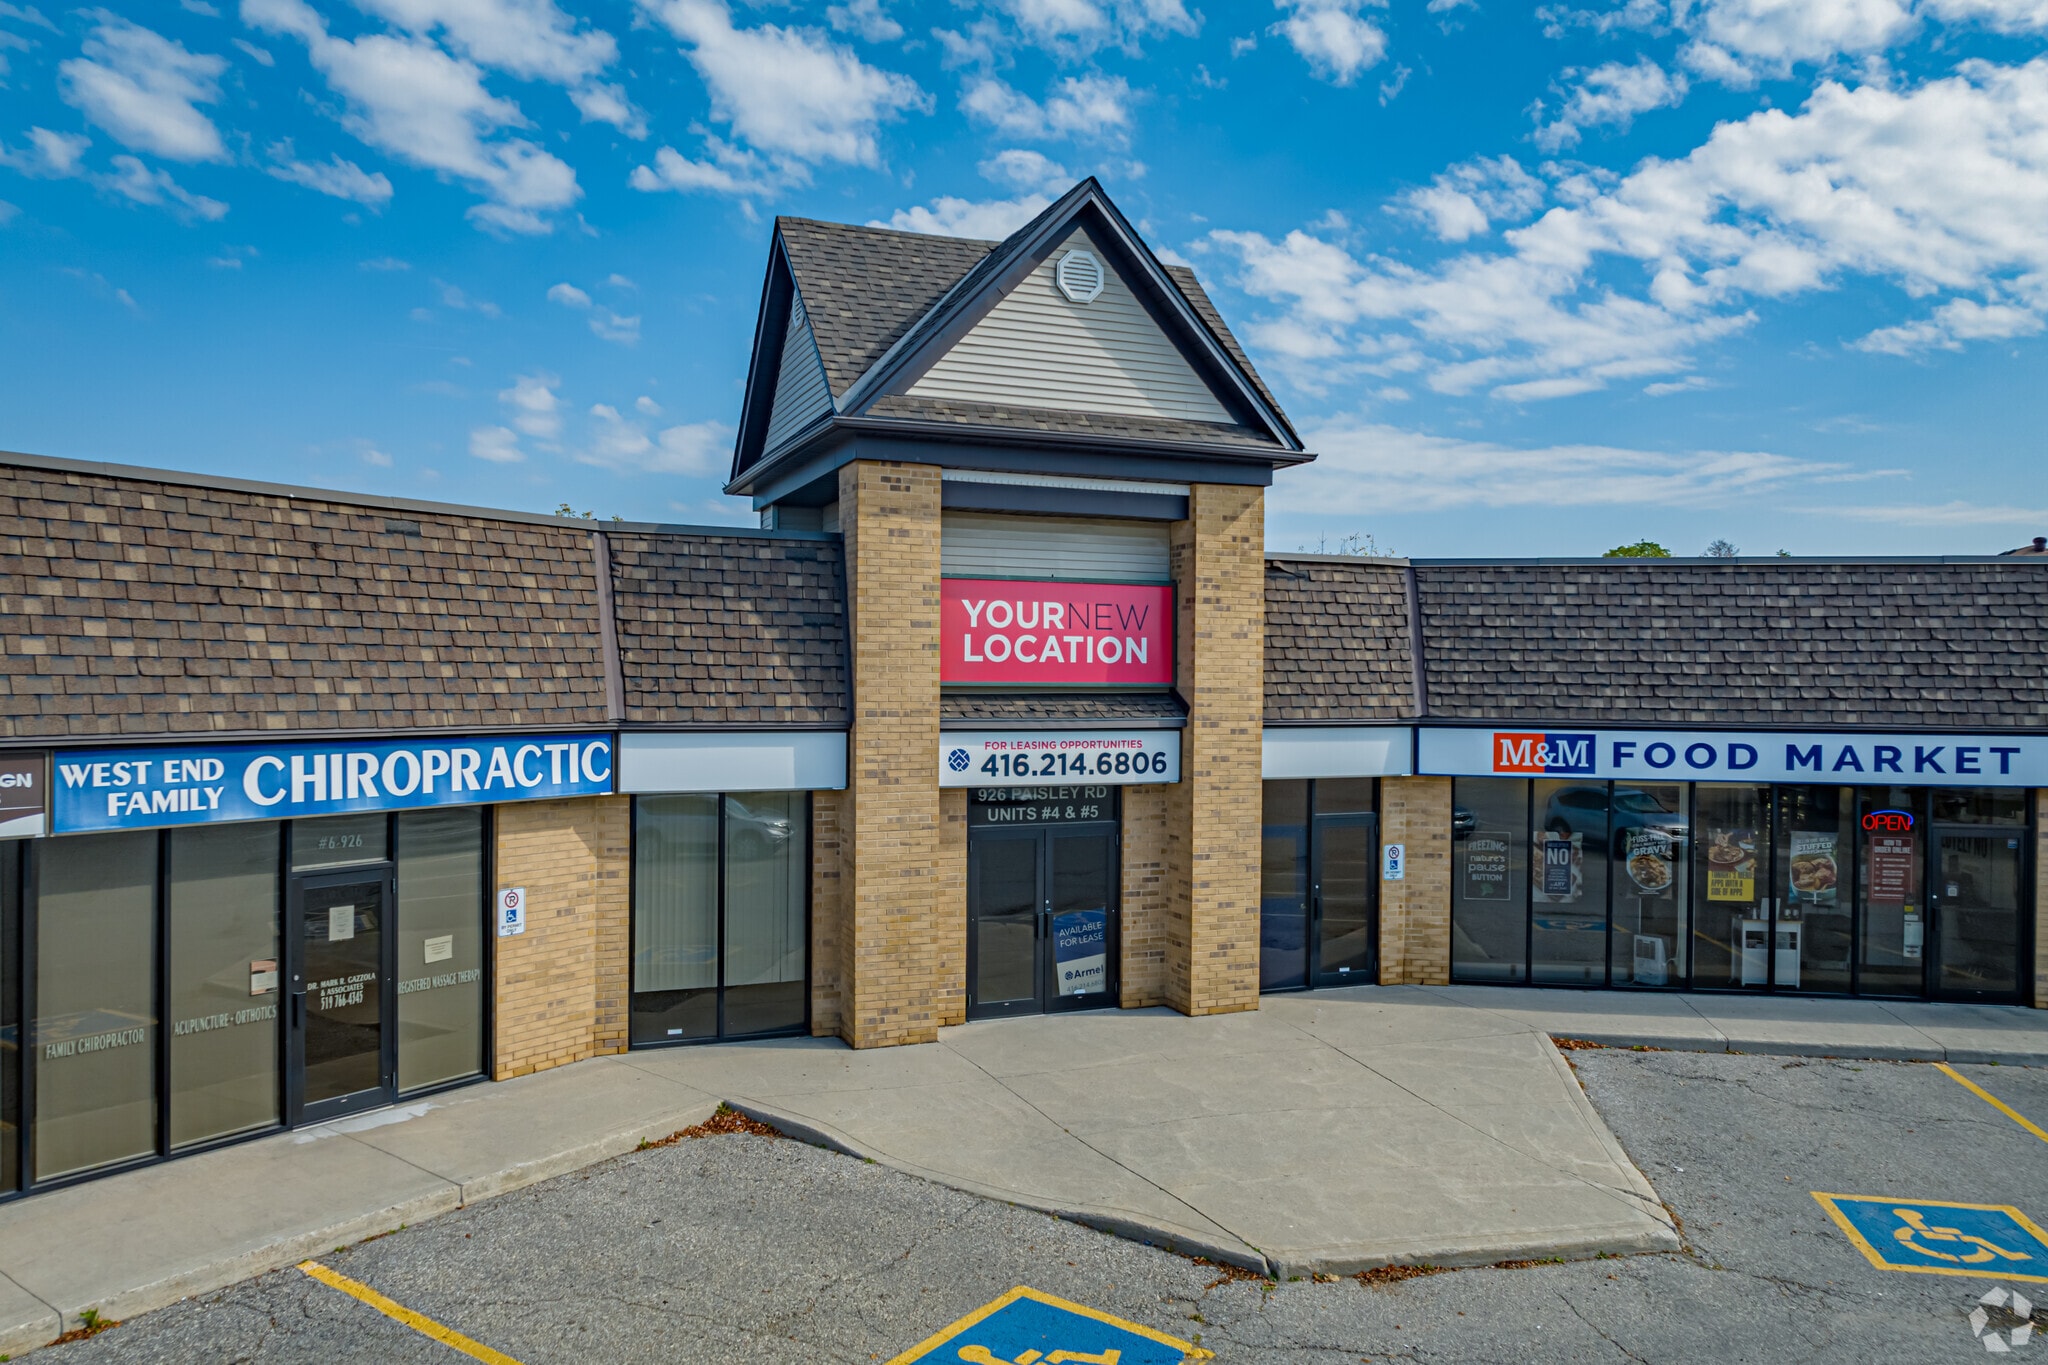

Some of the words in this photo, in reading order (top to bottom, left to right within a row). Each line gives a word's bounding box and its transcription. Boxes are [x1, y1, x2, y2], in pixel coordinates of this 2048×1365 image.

[961, 599, 1065, 630] YOUR
[1068, 602, 1149, 632] NEW
[963, 633, 1148, 664] LOCATION
[984, 741, 1008, 750] FOR
[1010, 740, 1057, 750] LEASING
[1060, 739, 1143, 750] OPPORTUNITIES
[980, 751, 1167, 777] 416.214.6806
[1499, 739, 1590, 768] M&M
[1612, 741, 1759, 770] FOOD
[1785, 743, 2021, 775] MARKET
[59, 760, 152, 789] WEST
[163, 758, 225, 784] END
[242, 741, 611, 806] CHIROPRACTIC
[107, 786, 225, 817] FAMILY
[977, 787, 1006, 802] 926
[1011, 785, 1081, 801] PAISLEY
[1084, 785, 1107, 799] RD
[987, 806, 1037, 821] UNITS
[1041, 806, 1060, 820] #4
[1064, 805, 1076, 819] &
[1080, 805, 1098, 819] #5
[1862, 813, 1911, 831] OPEN
[1633, 845, 1667, 856] GRAVY
[1797, 842, 1832, 851] STUFFED
[1547, 848, 1569, 865] NO
[1468, 863, 1506, 874] pause
[1471, 873, 1503, 881] BUTTON
[1059, 921, 1103, 937] AVAILABLE
[1060, 937, 1078, 948] FOR
[1078, 932, 1104, 944] LEASE
[1074, 964, 1104, 979] Armel
[320, 978, 339, 989] MARK
[326, 982, 364, 995] ASSOCIATES
[398, 976, 432, 994] REGISTERED
[432, 972, 457, 988] MASSAGE
[457, 968, 481, 984] THERAPY
[320, 996, 333, 1010] 519
[174, 1012, 229, 1036] ACUPUNCTURE
[235, 1005, 277, 1025] ORTHOTICS
[45, 1040, 75, 1060] FAMILY
[78, 1028, 145, 1054] CHIROPRACTOR
